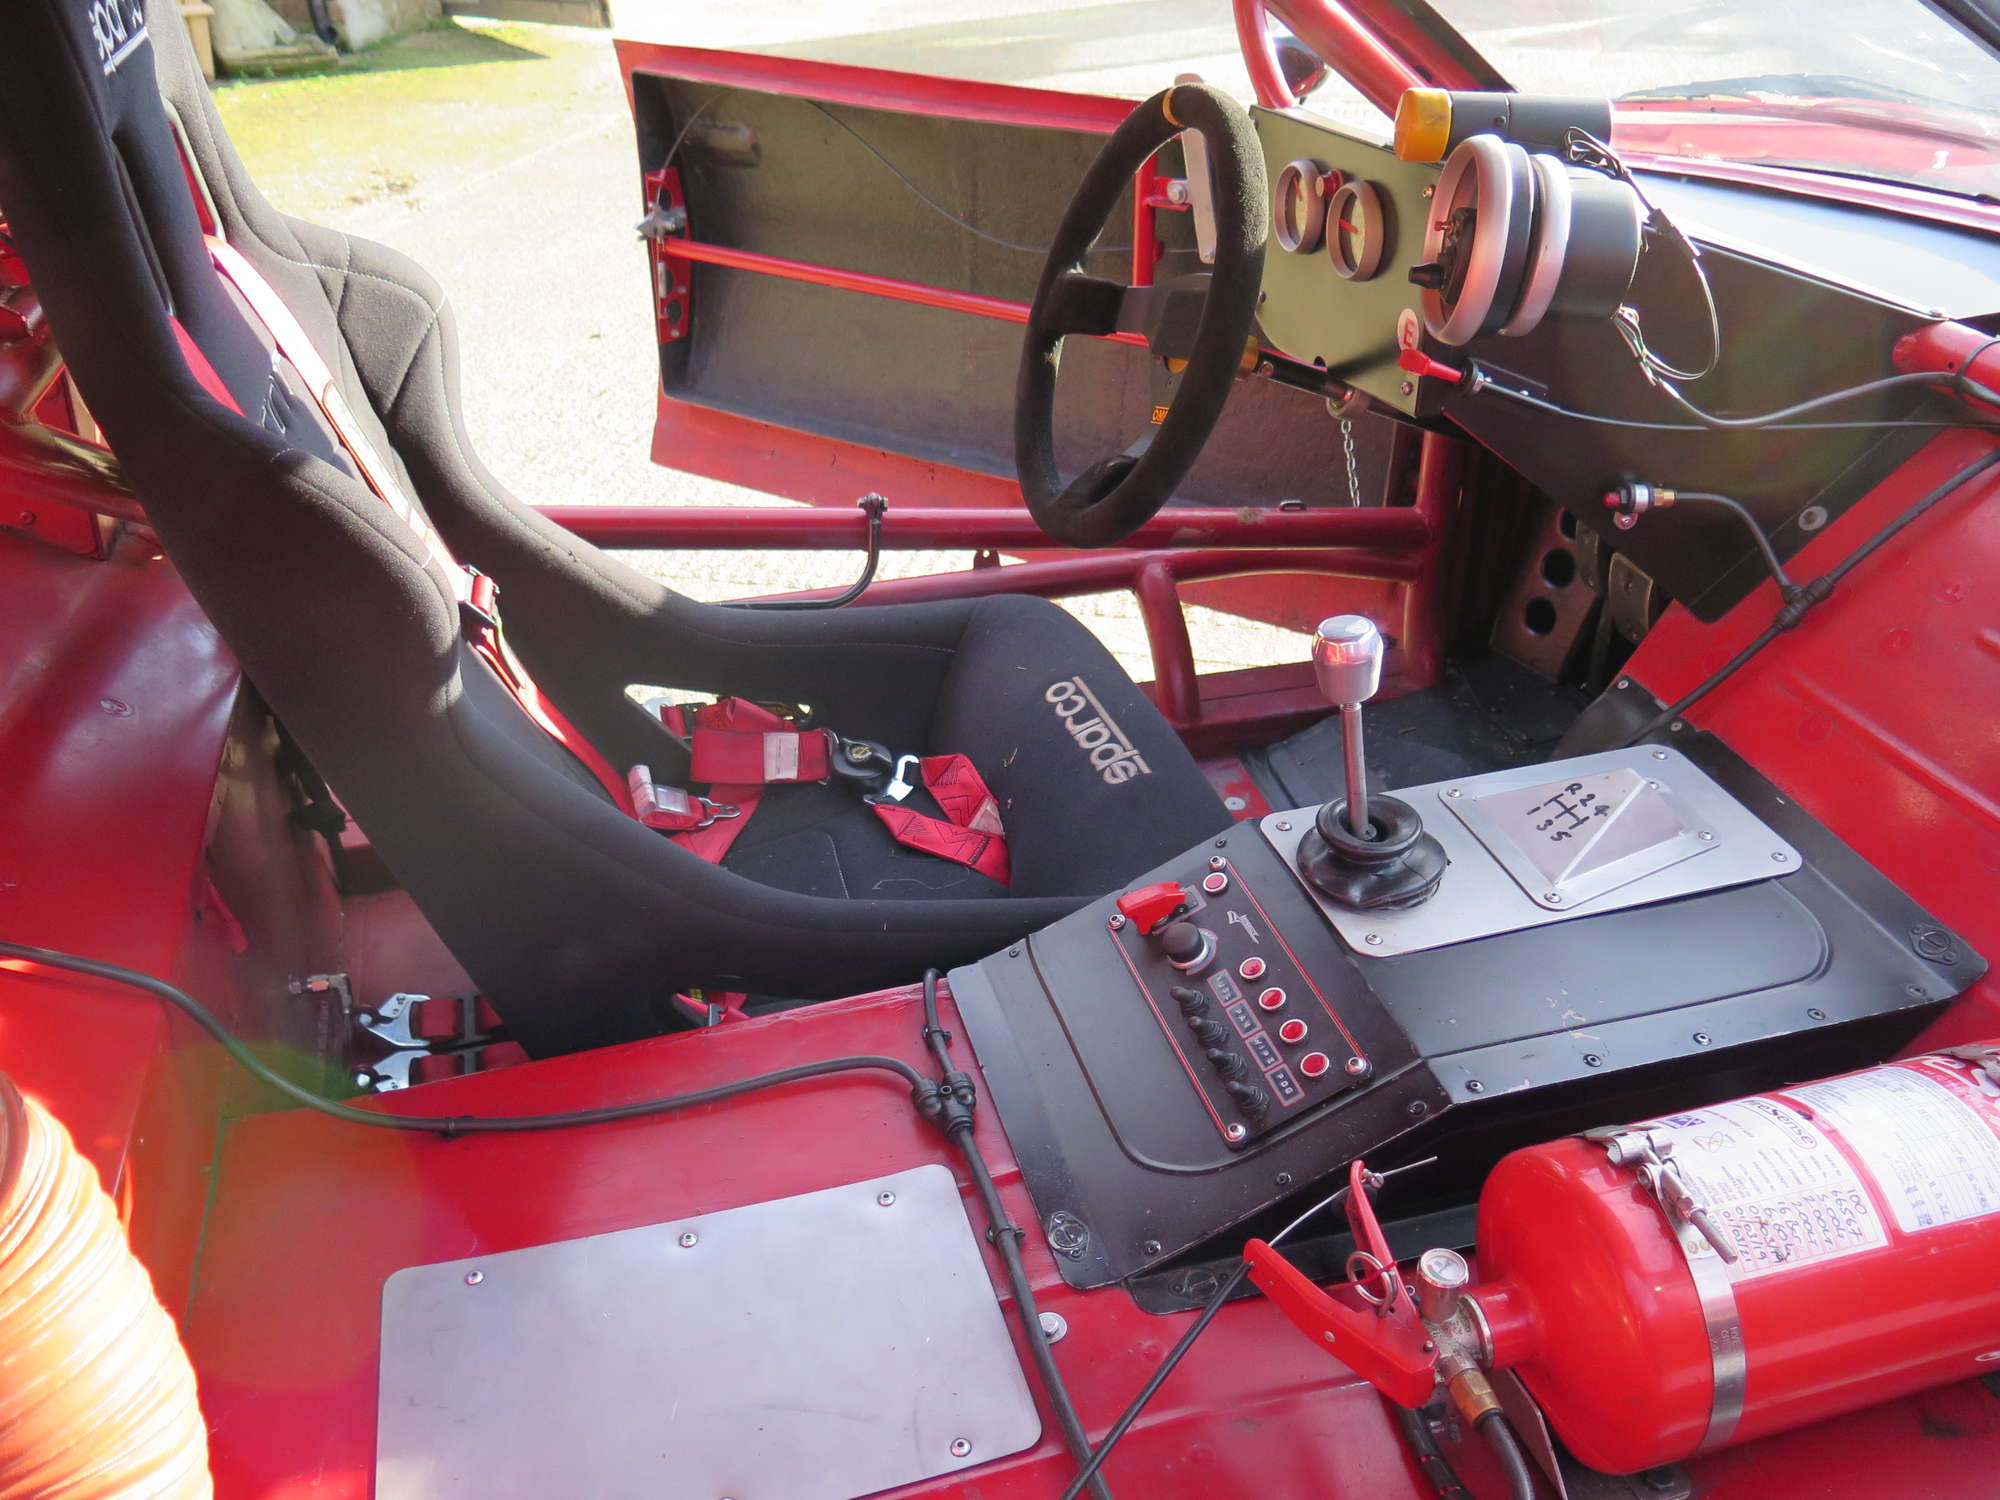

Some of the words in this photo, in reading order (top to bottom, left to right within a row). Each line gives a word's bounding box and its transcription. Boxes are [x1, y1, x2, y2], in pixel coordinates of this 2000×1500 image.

[1045, 677, 1148, 784] sparco
[1564, 783, 1583, 795] R
[1580, 793, 1596, 807] 2
[1536, 819, 1554, 831] 3
